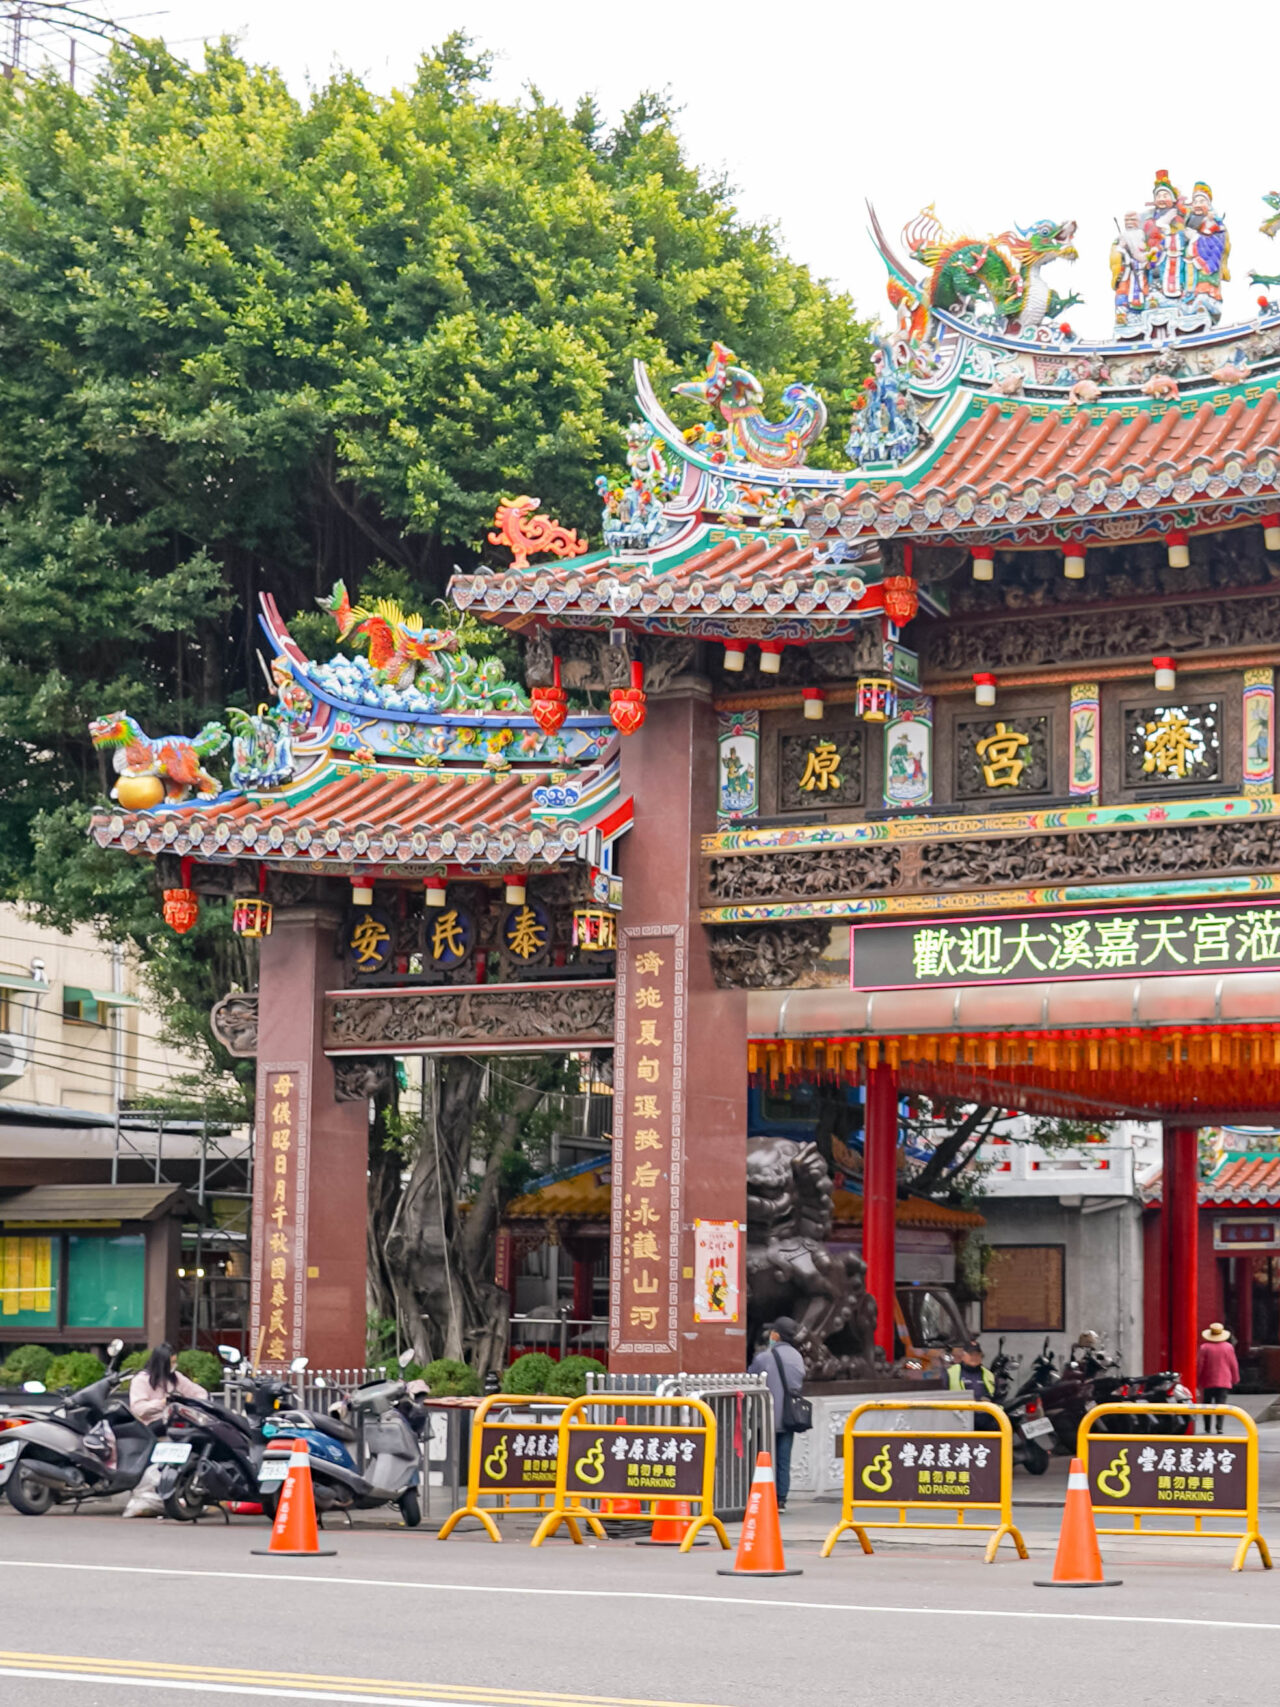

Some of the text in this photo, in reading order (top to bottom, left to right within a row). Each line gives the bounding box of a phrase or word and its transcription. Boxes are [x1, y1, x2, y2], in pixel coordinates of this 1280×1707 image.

[267, 1074, 294, 1361] 母儀昭日月千秋國泰民安
[512, 1433, 558, 1457] 豐原慈濟
[611, 1436, 697, 1462] 豐原慈濟宮
[898, 1442, 991, 1468] 豐原慈濟宮
[1137, 1446, 1236, 1474] 豐原慈濟宮
[627, 1463, 676, 1477] 請勿停車
[918, 1470, 970, 1484] 請勿停車
[627, 1477, 676, 1488] NO PARKING
[918, 1485, 970, 1495] NO PARKING
[1158, 1475, 1214, 1490] 請勿停車
[1158, 1490, 1214, 1502] NO PARKING
